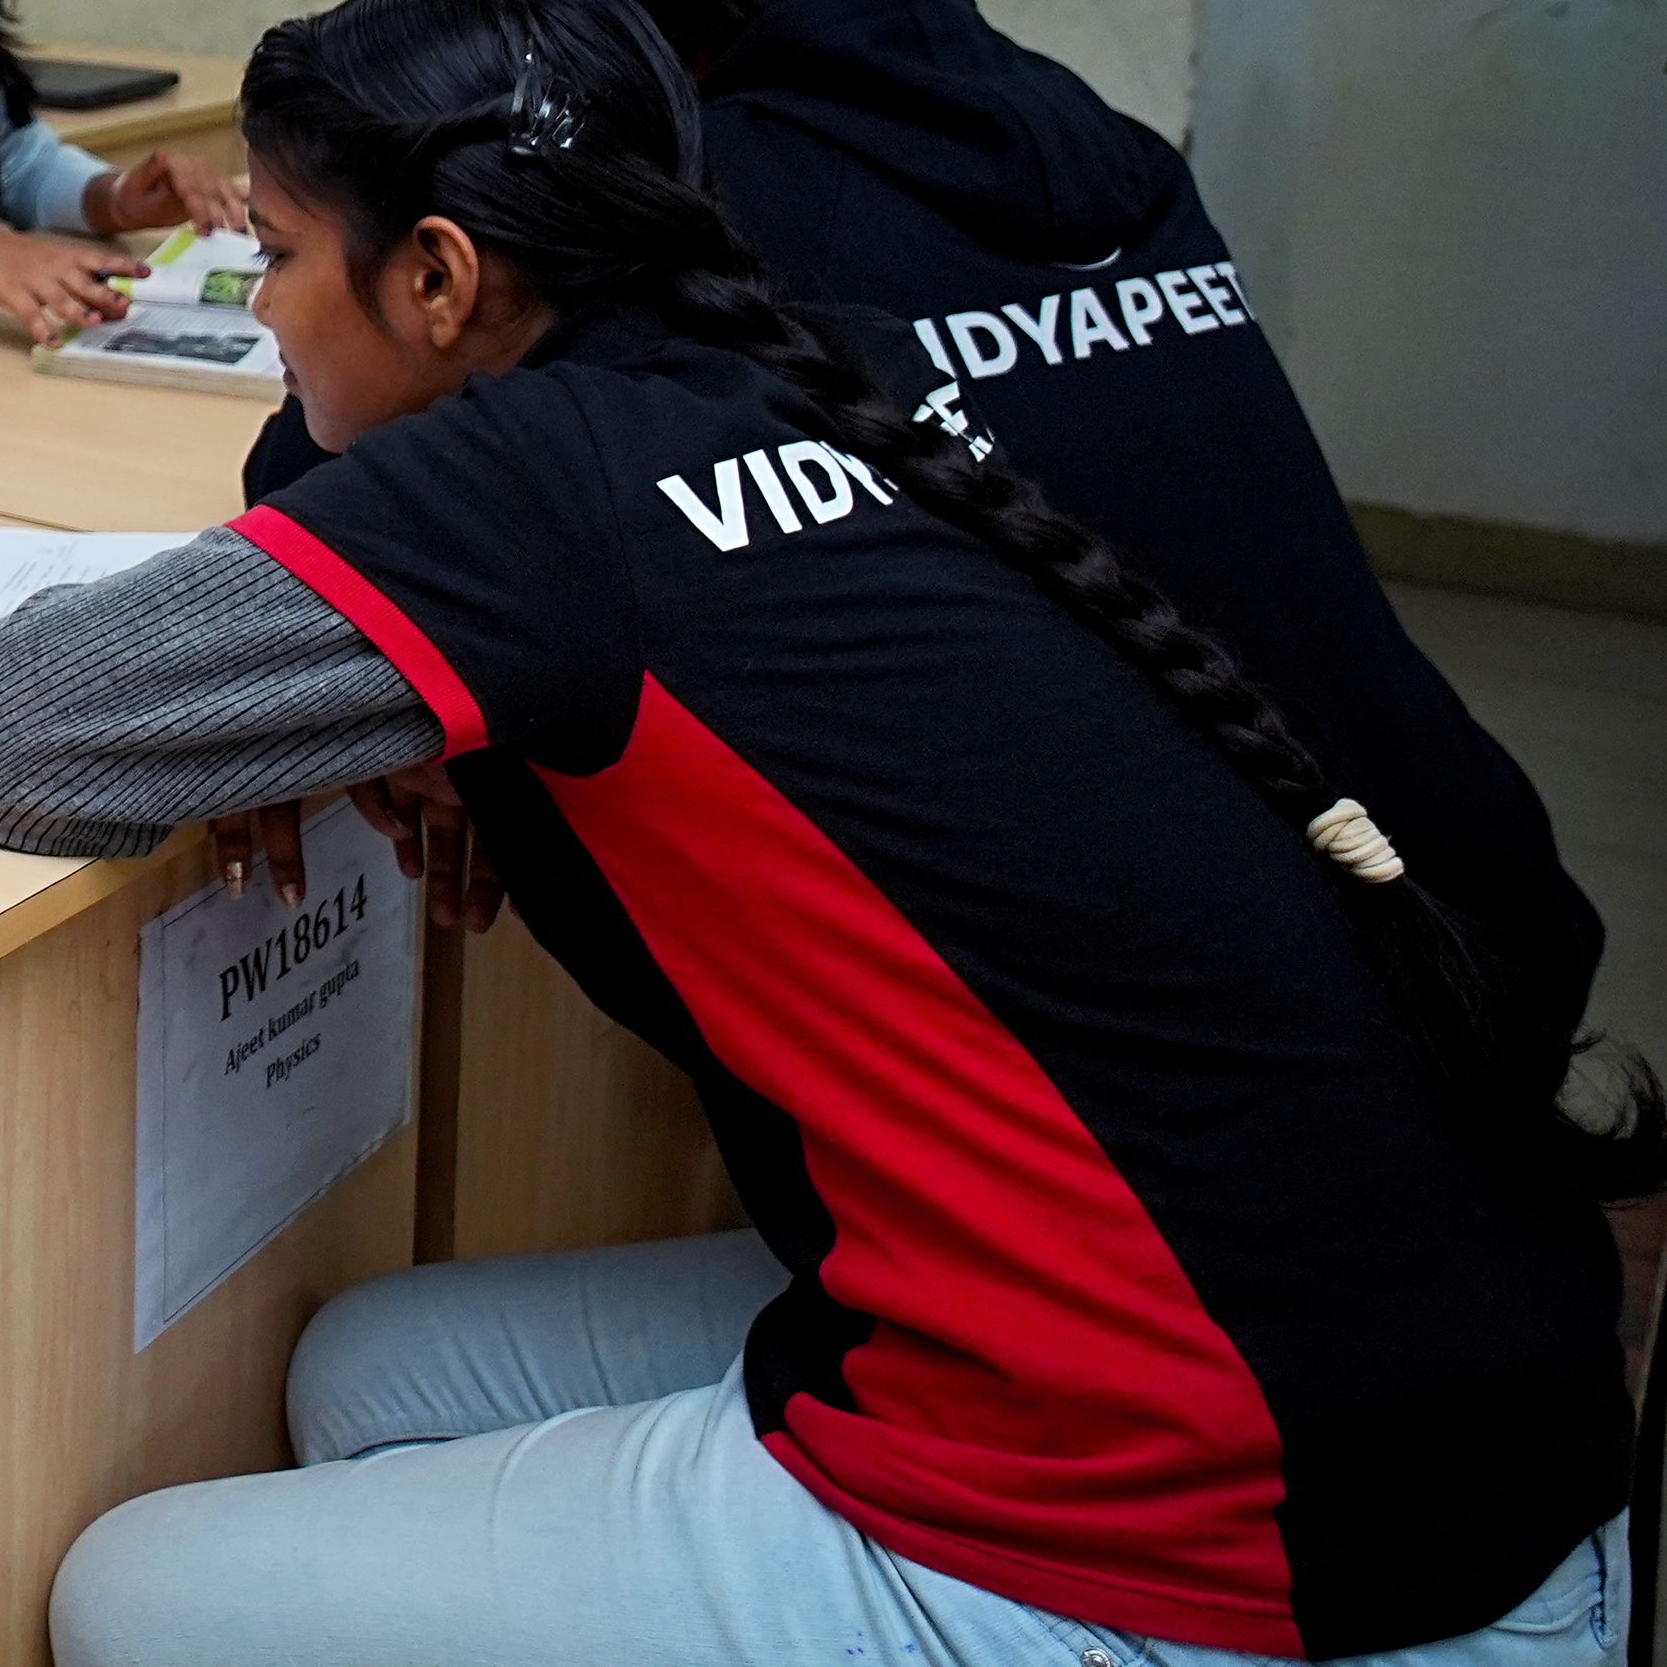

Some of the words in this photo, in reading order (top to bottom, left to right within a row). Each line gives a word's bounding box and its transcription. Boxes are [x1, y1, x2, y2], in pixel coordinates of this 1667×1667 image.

[219, 873, 366, 1022] PW18614
[224, 1026, 266, 1076] Ajeet
[267, 990, 317, 1042] kumar
[319, 960, 360, 1009] gupta
[267, 1032, 321, 1089] Physics
